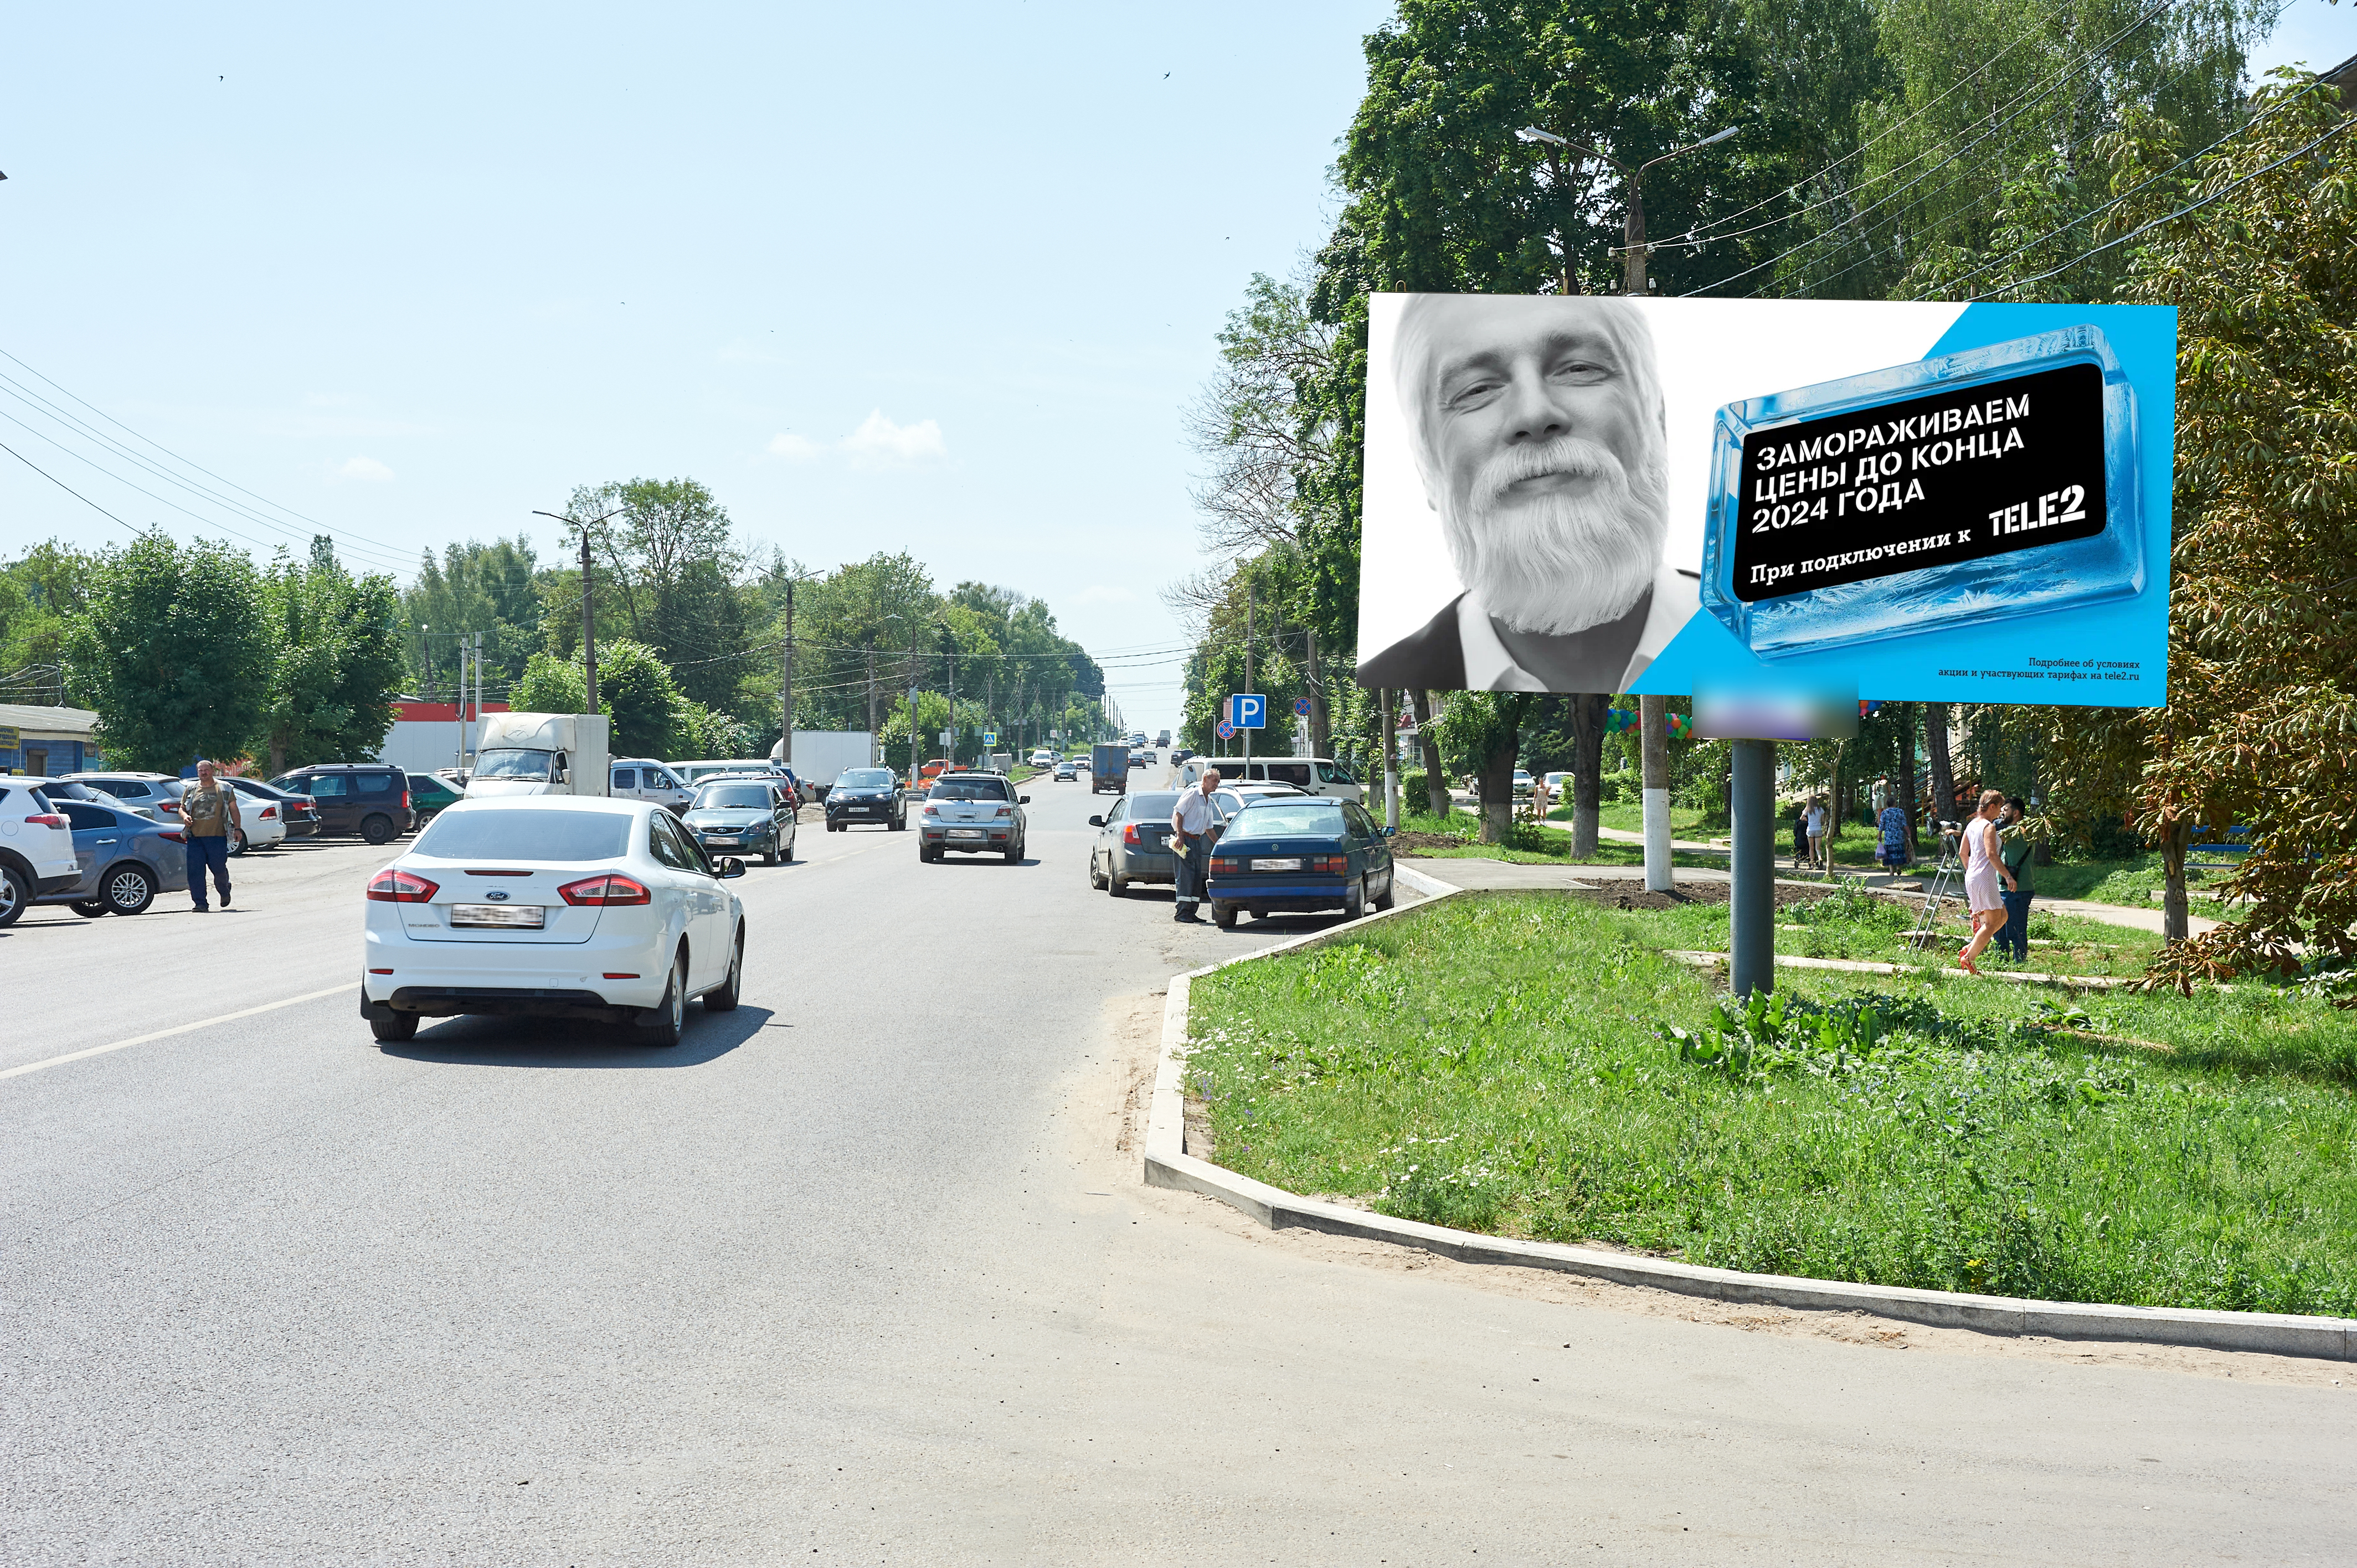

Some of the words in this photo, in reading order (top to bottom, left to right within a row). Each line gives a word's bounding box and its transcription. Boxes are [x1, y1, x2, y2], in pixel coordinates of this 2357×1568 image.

[1757, 394, 2029, 470] ЗАМОРАЖИВАЕМ
[1756, 462, 1846, 504] ЦЕНЫ
[1855, 452, 1902, 487] ДО
[1912, 427, 2024, 470] КОНЦА
[1752, 497, 1828, 533] 2024
[1839, 478, 1924, 516] ГОДА
[1751, 564, 1794, 585] При
[1801, 533, 1951, 574] подключении
[1958, 529, 1970, 543] к
[1989, 485, 2085, 536] TELE2
[1980, 670, 2045, 680] участвующих
[2047, 670, 2087, 682] тарифах
[2104, 671, 2139, 680] tele2.ru
[2029, 657, 2080, 669] Подробнее
[2082, 658, 2094, 668] об
[2096, 661, 2140, 670] условиях
[1241, 699, 1259, 724] P
